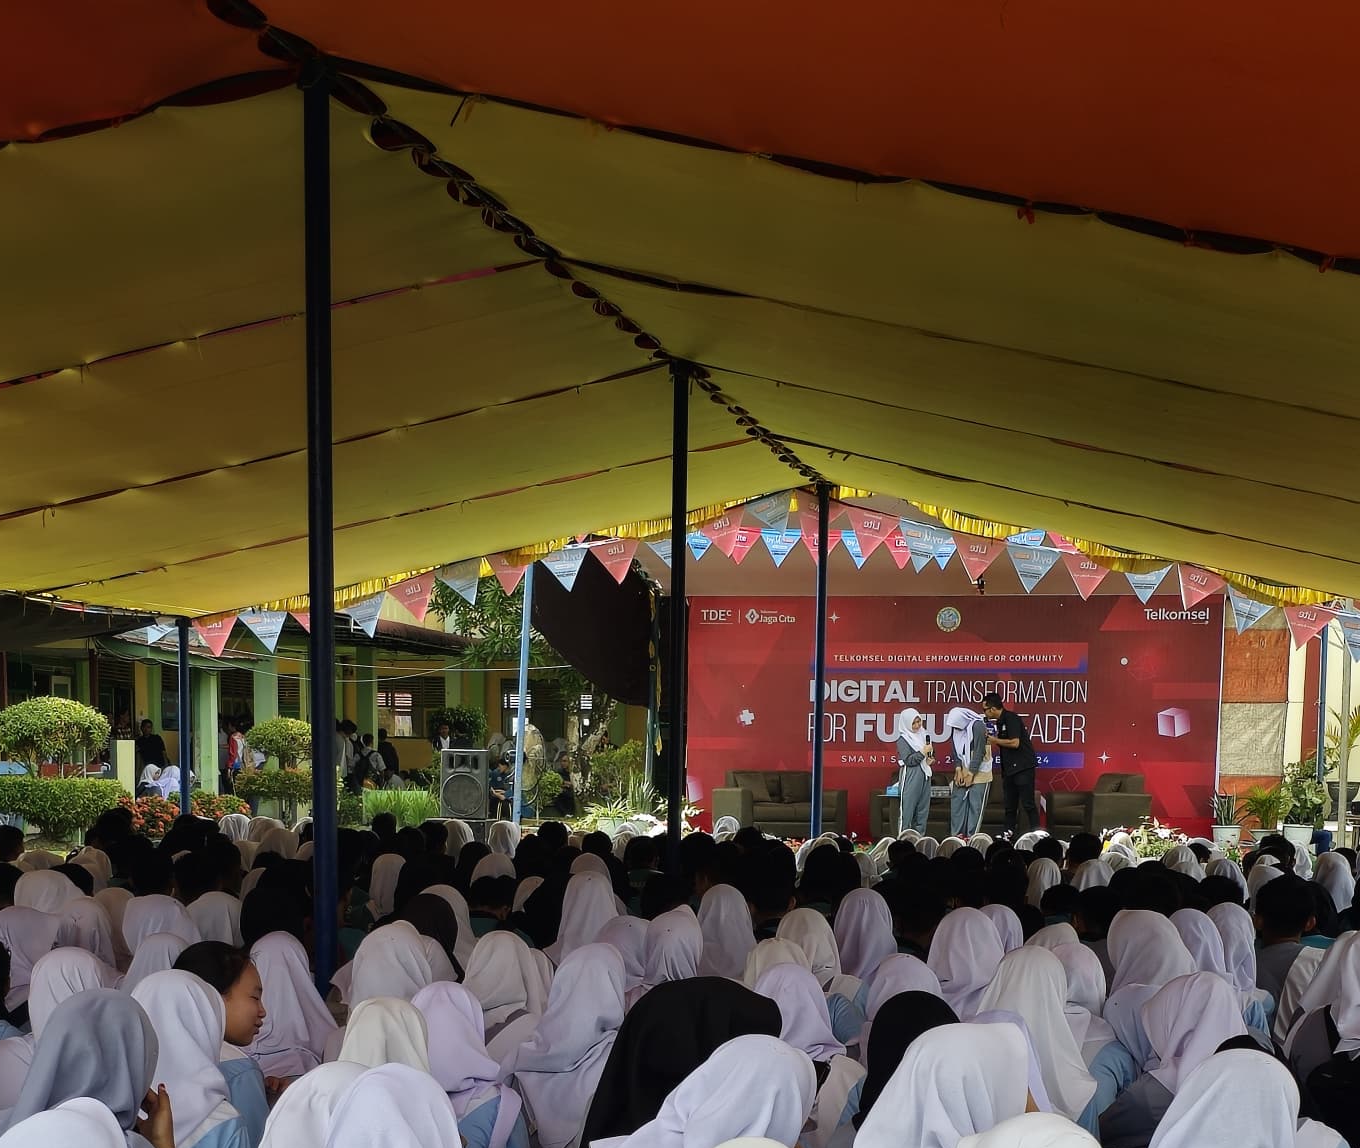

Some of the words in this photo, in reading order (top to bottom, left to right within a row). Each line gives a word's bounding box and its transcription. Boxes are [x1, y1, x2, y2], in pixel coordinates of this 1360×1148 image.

[1144, 607, 1210, 621] Telkomsel
[833, 654, 885, 662] TELKOMSEL
[887, 654, 923, 662] DIGITAL
[925, 654, 986, 662] EMPOWERING
[988, 654, 1007, 662] FOR
[1008, 654, 1065, 662] COMMUNITY
[841, 755, 865, 763] SMA
[870, 755, 877, 763] N
